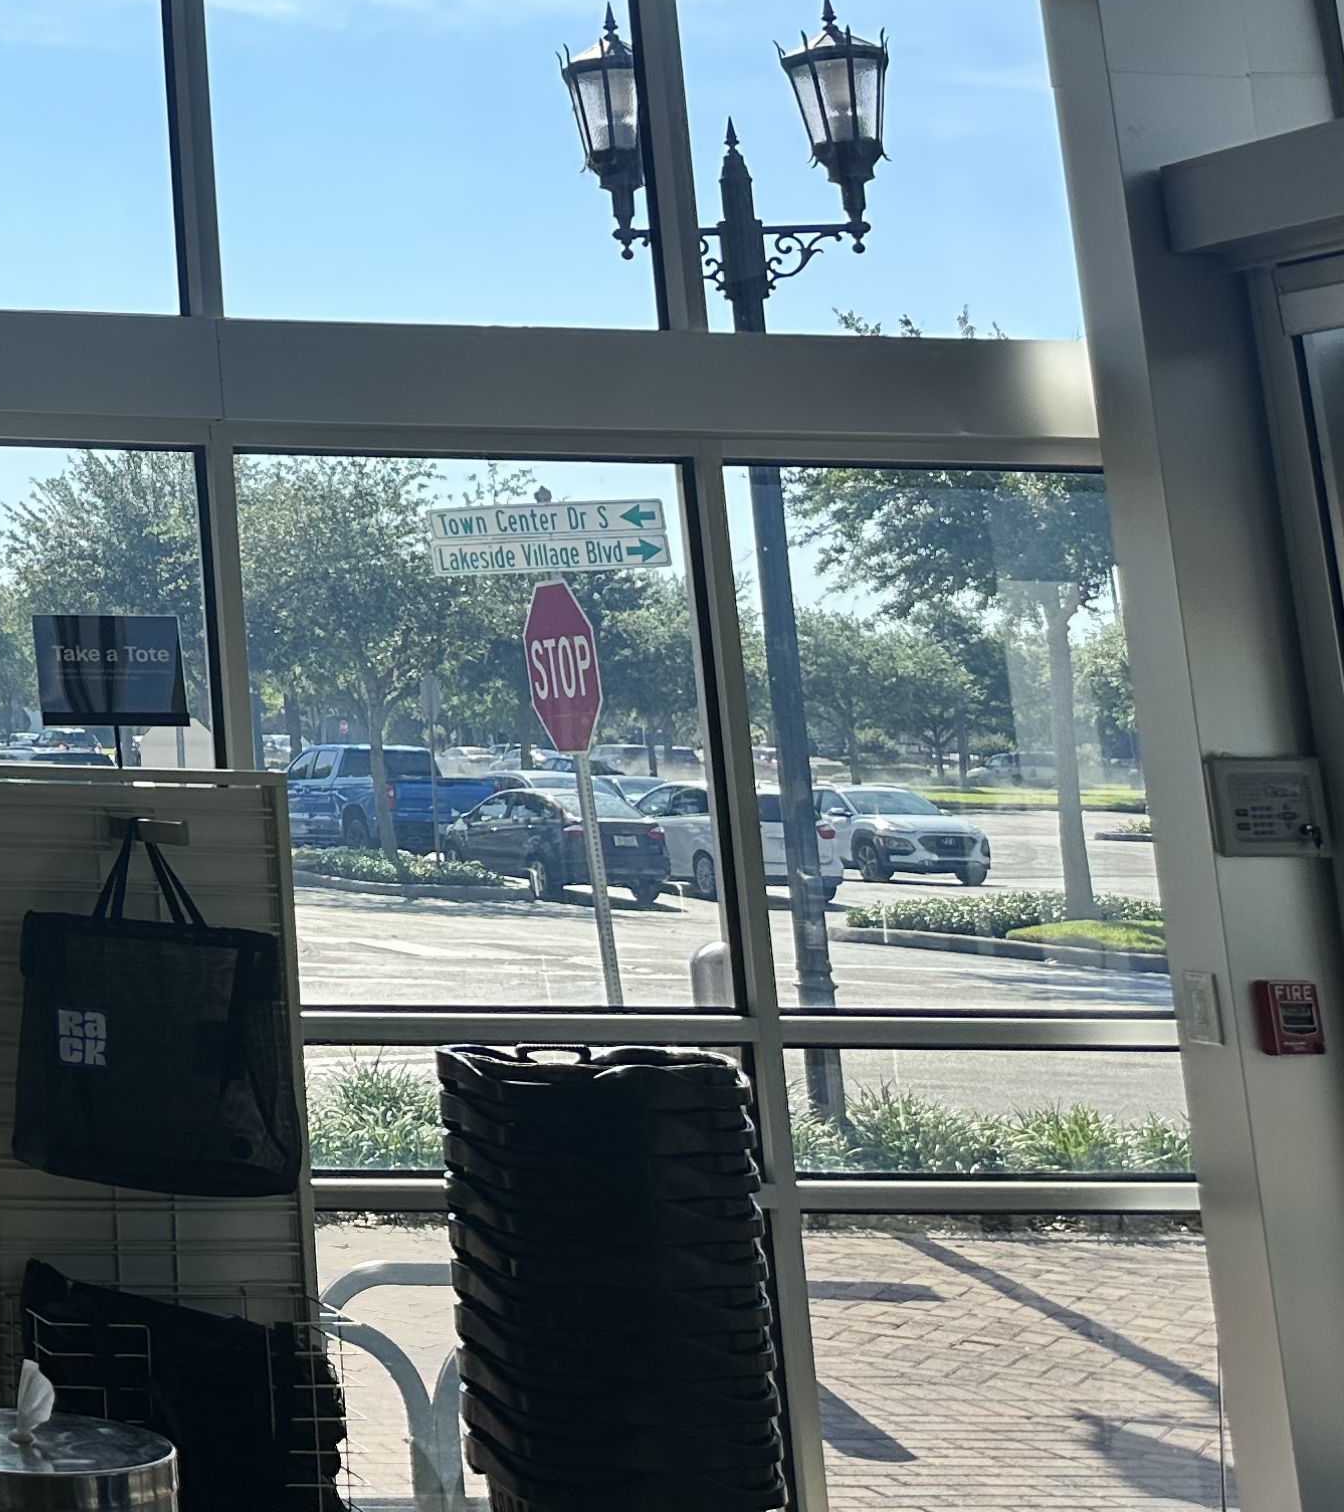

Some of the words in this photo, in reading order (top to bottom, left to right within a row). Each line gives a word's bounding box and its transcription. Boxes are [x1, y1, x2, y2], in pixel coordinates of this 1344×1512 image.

[437, 513, 488, 536] Town
[495, 505, 558, 533] Center
[566, 505, 587, 531] Dr
[597, 505, 610, 529] S
[438, 544, 516, 572] Lakeside
[520, 540, 580, 569] Village
[585, 538, 624, 564] Blvd
[51, 645, 101, 663] Take
[106, 649, 118, 662] a
[123, 645, 170, 663] Tote
[530, 635, 591, 701] STOP
[1274, 985, 1313, 1001] FIRE
